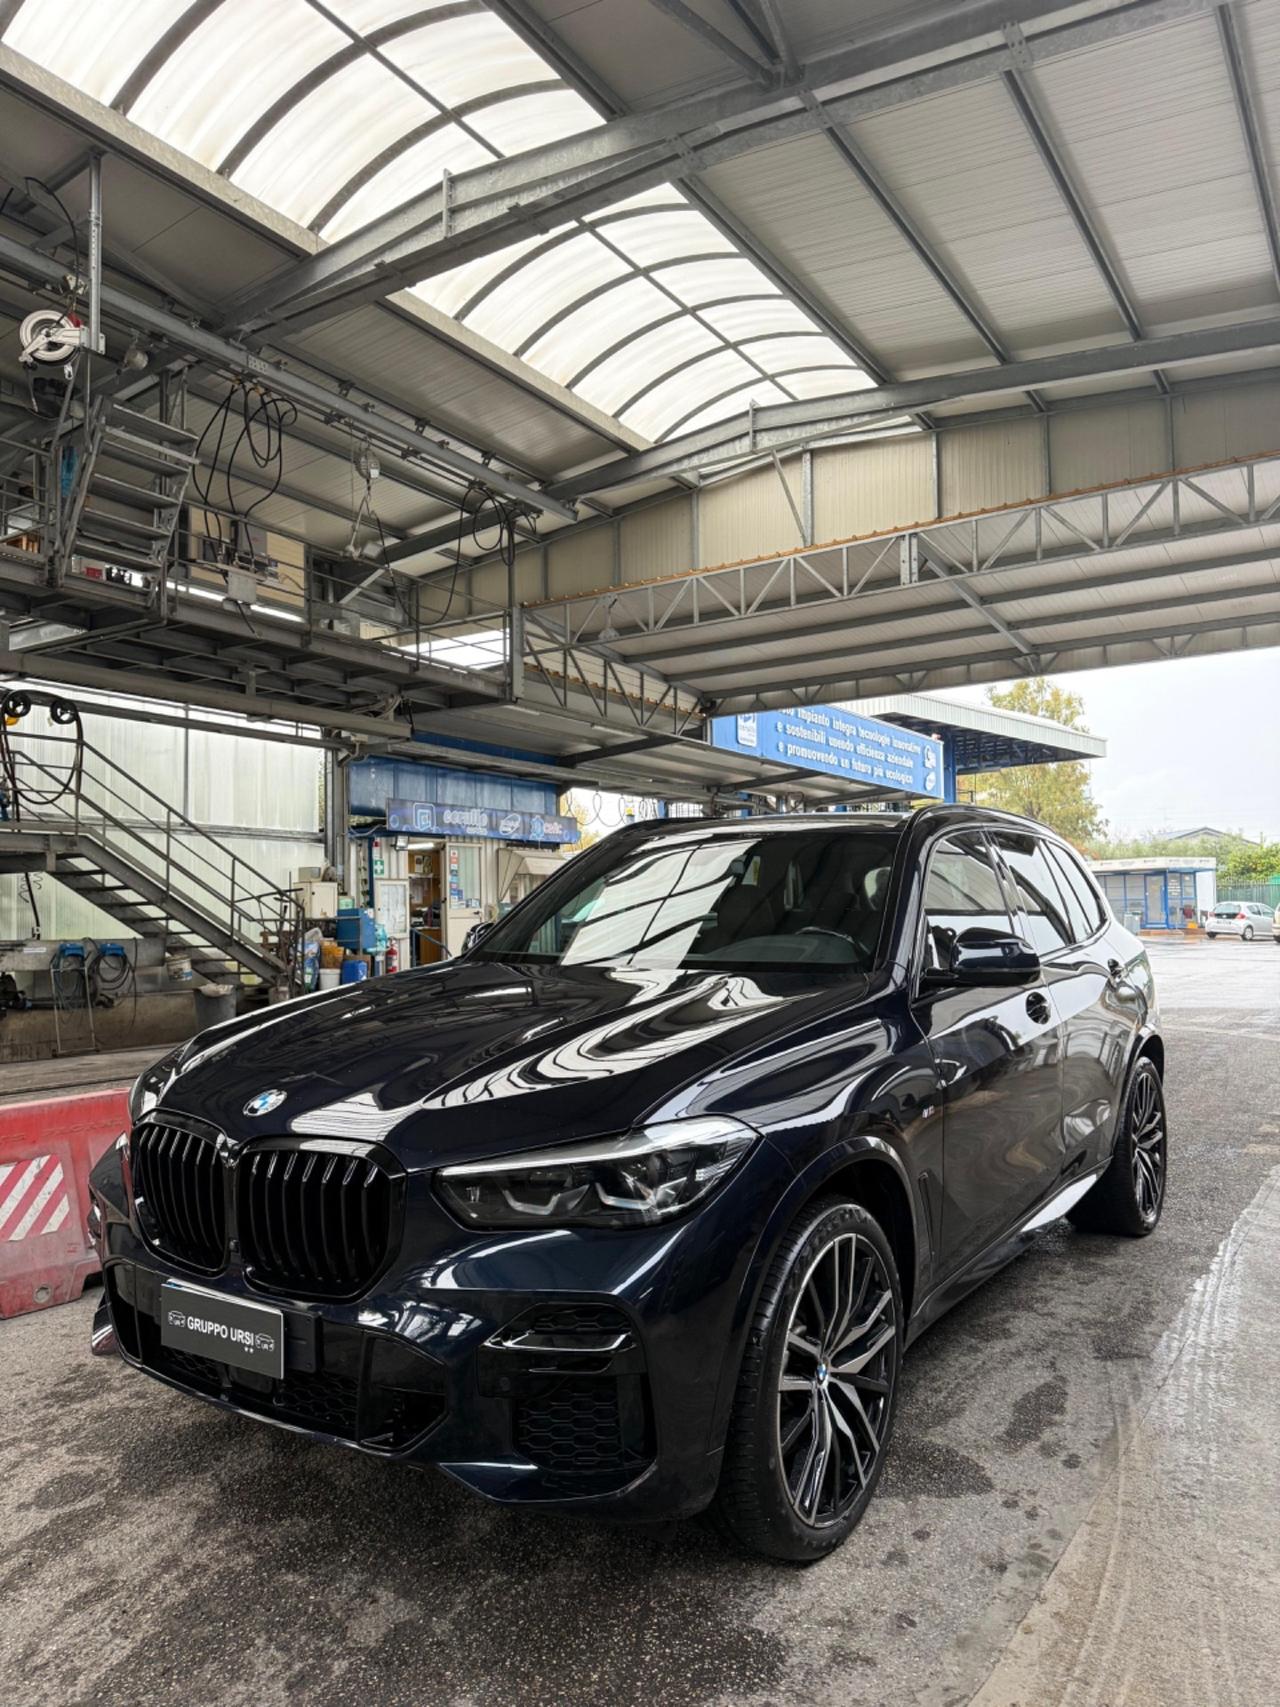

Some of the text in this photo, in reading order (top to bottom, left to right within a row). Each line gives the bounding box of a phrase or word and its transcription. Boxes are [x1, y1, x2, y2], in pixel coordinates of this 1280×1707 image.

[777, 721, 784, 733] e
[786, 723, 827, 744] sostenibili
[833, 716, 856, 736] integra
[778, 741, 785, 752] e
[787, 743, 838, 765] promuovendo
[187, 1315, 254, 1346] GRUPPO URSI
